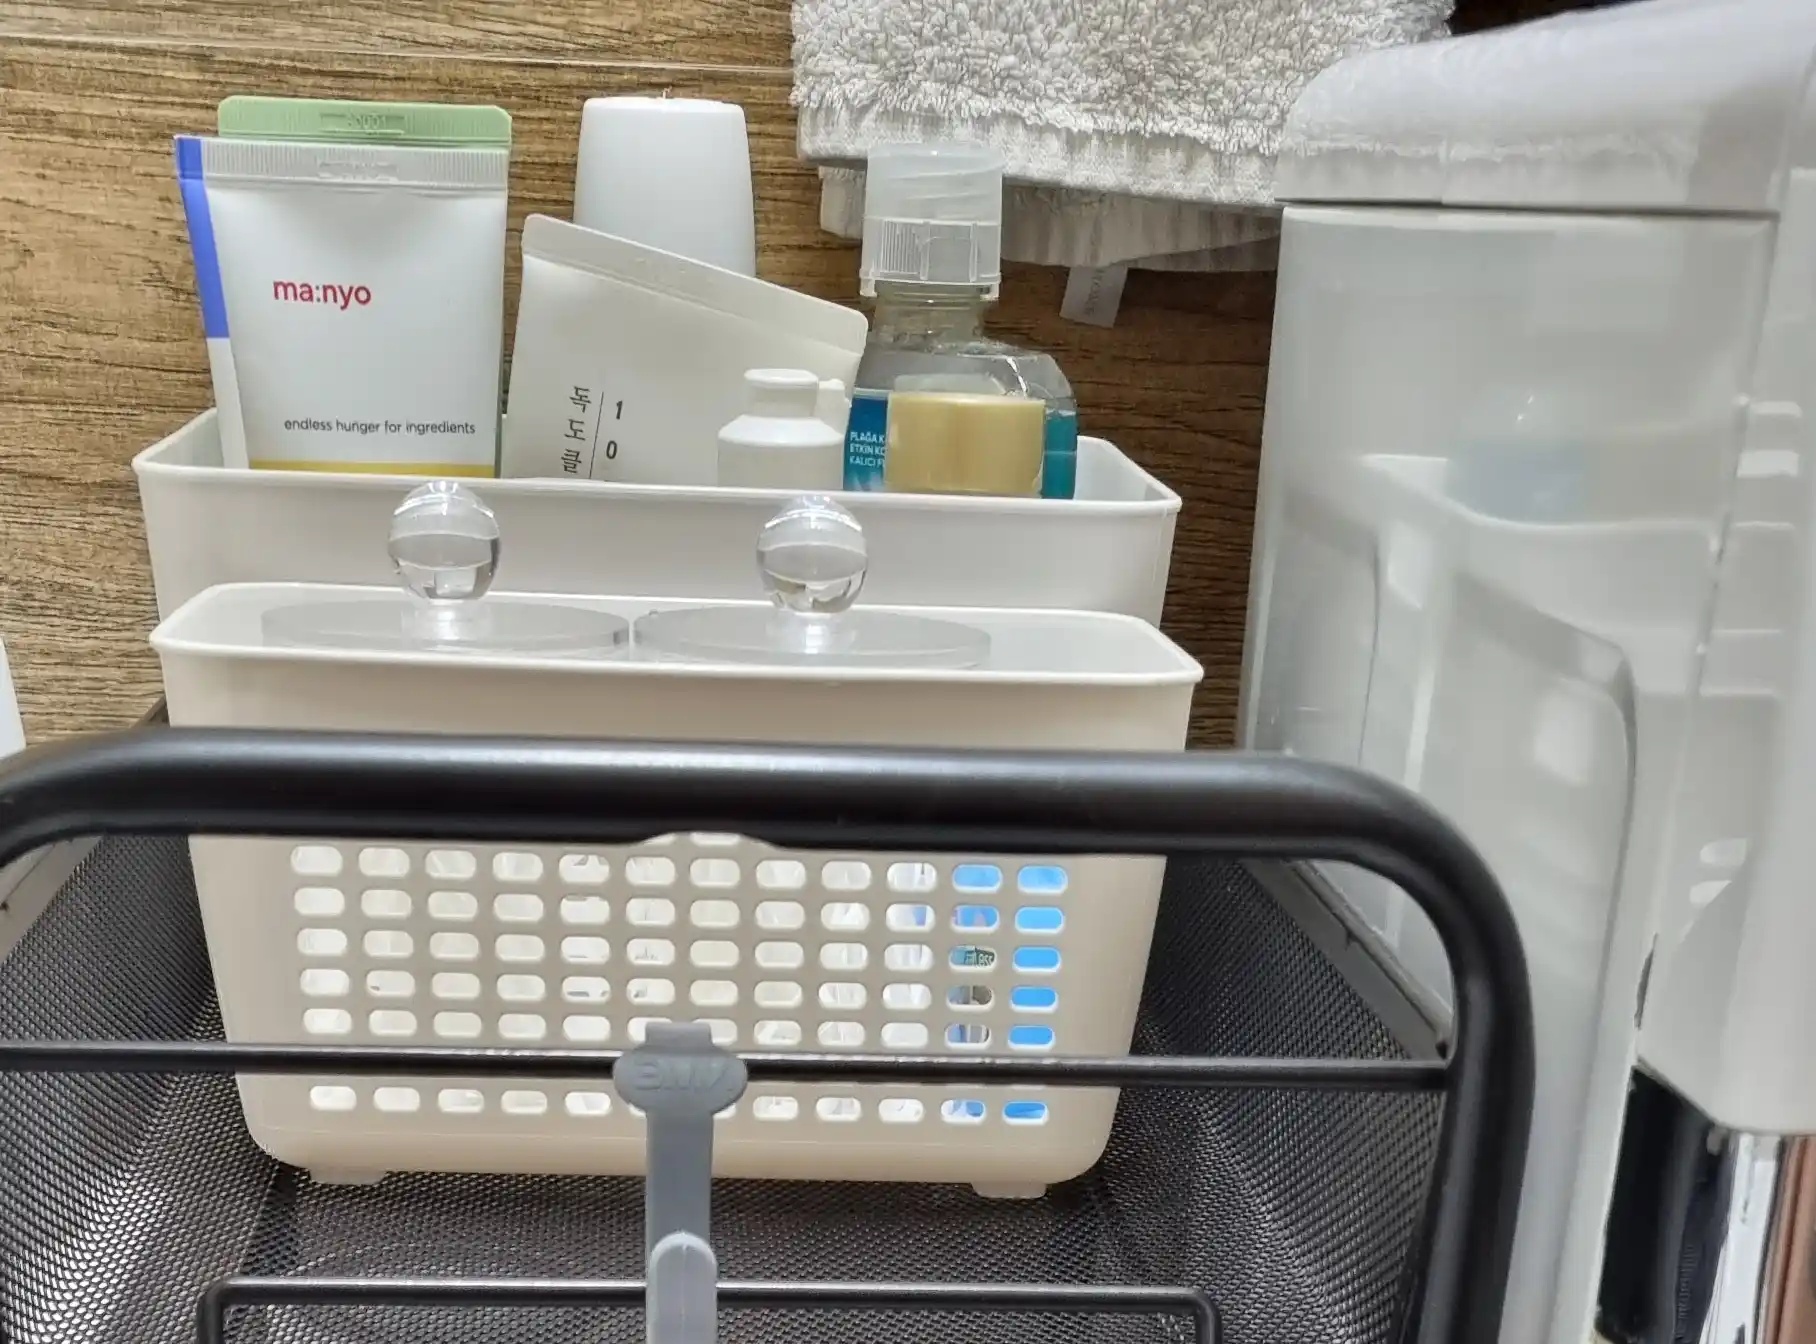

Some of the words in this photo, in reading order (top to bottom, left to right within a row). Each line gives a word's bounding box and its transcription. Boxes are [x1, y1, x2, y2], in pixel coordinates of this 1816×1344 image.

[273, 281, 372, 310] ma:nyo
[284, 418, 333, 432] endless
[336, 418, 380, 435] hunger
[384, 420, 401, 434] for
[406, 420, 476, 436] ingredients
